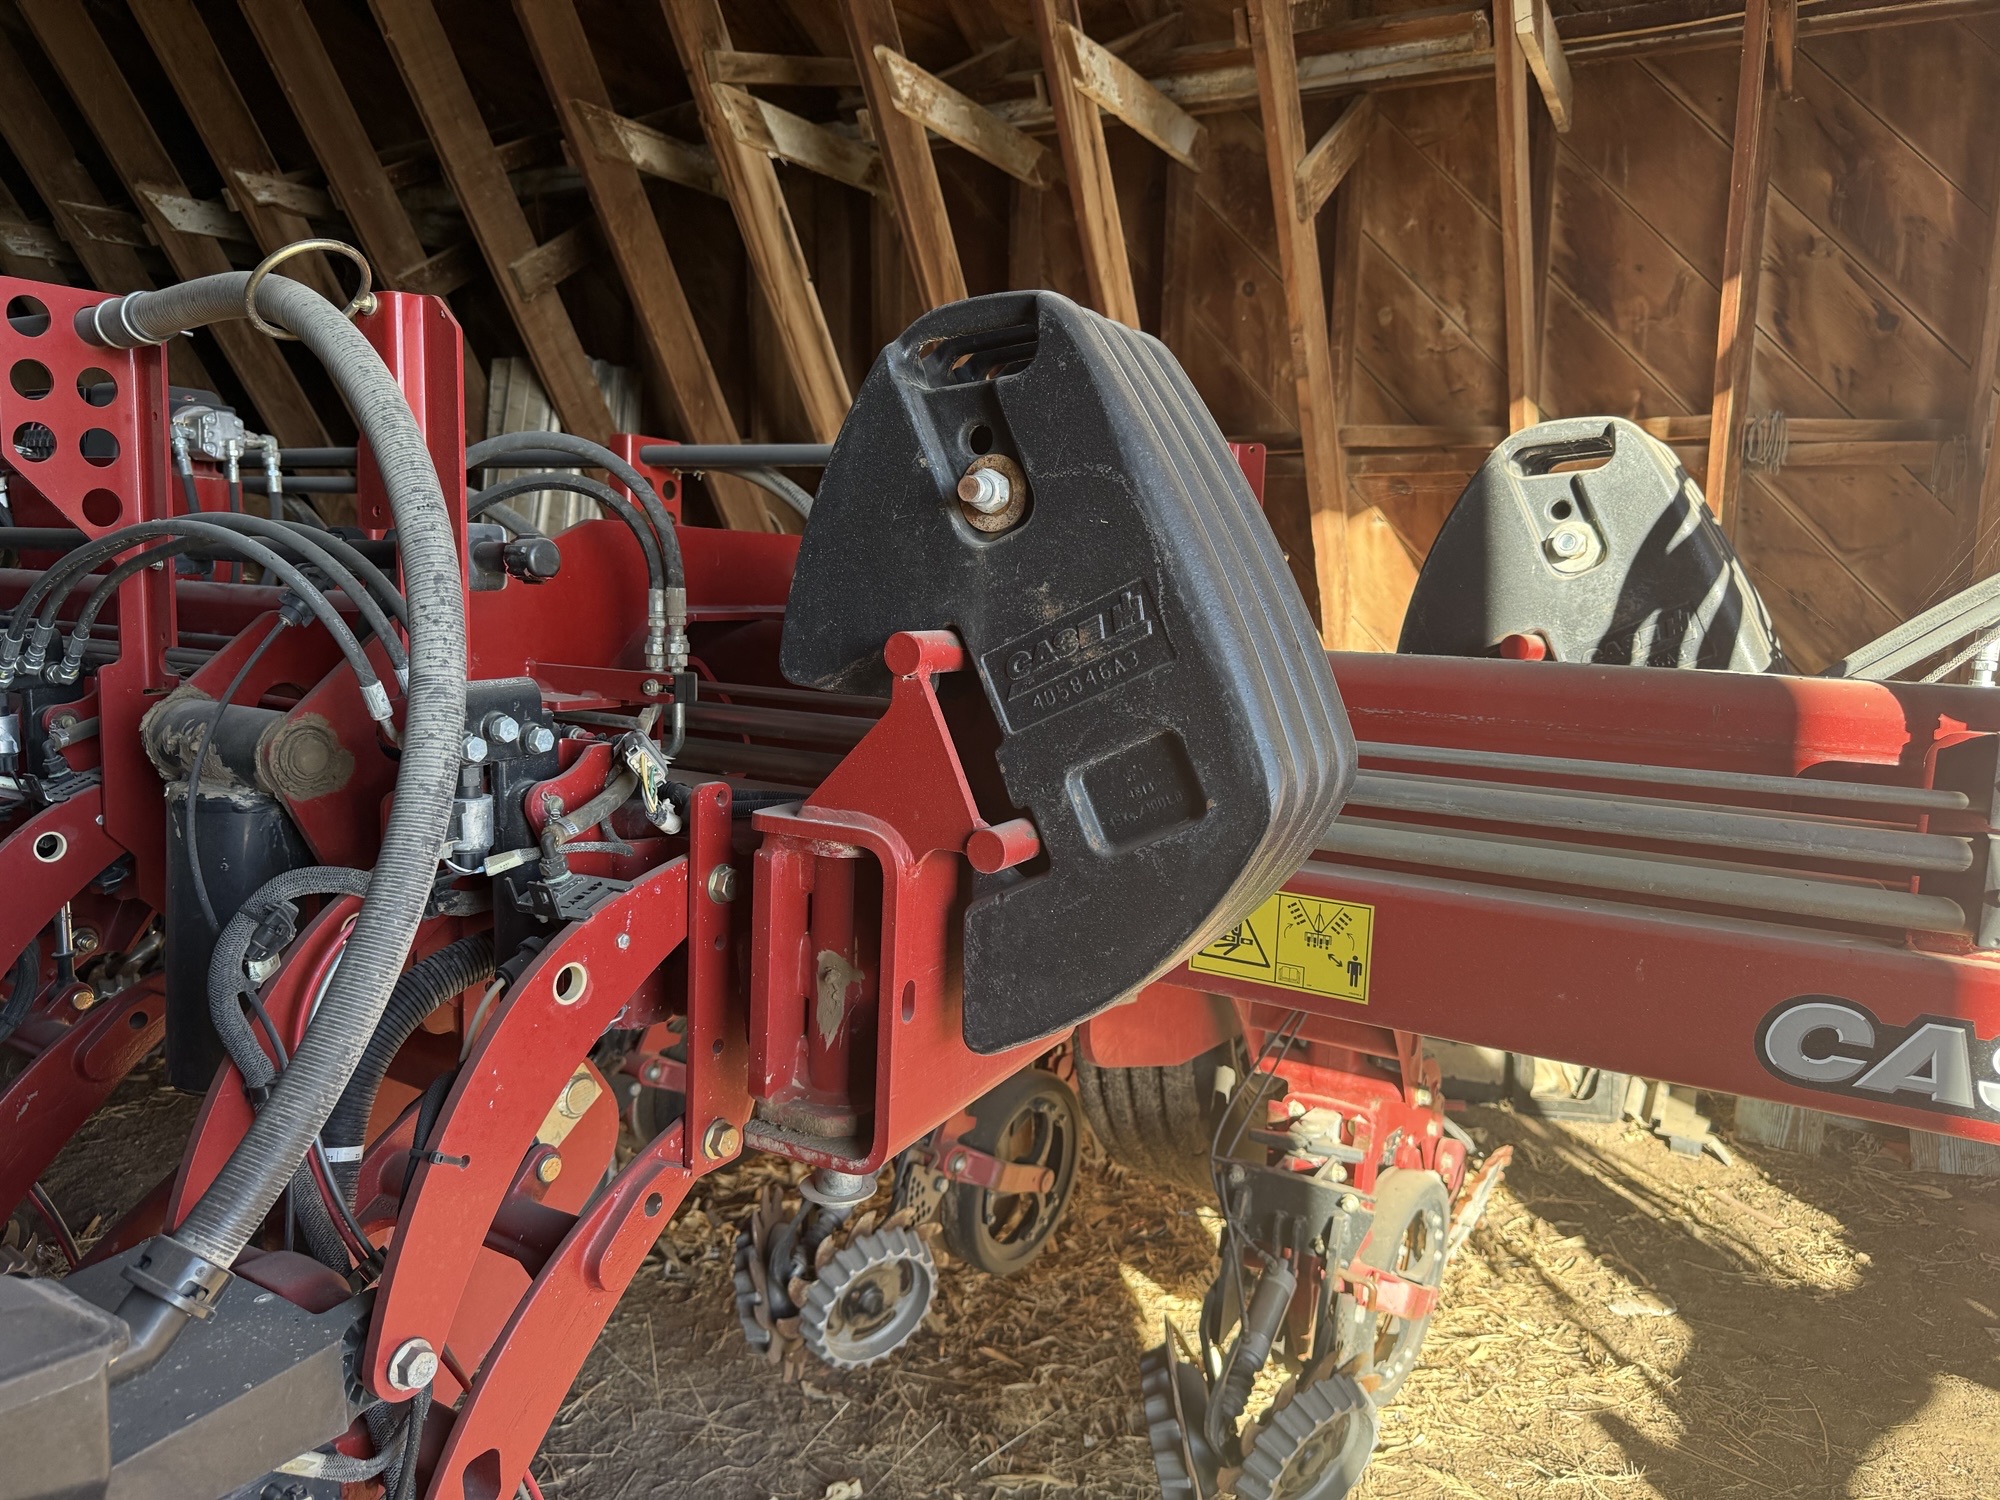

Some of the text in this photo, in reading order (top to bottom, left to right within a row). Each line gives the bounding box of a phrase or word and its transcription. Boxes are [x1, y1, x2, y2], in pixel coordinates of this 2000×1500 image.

[1005, 614, 1105, 681] CASE
[1032, 650, 1140, 710] 405846A3
[1764, 1002, 2000, 1113] CA
